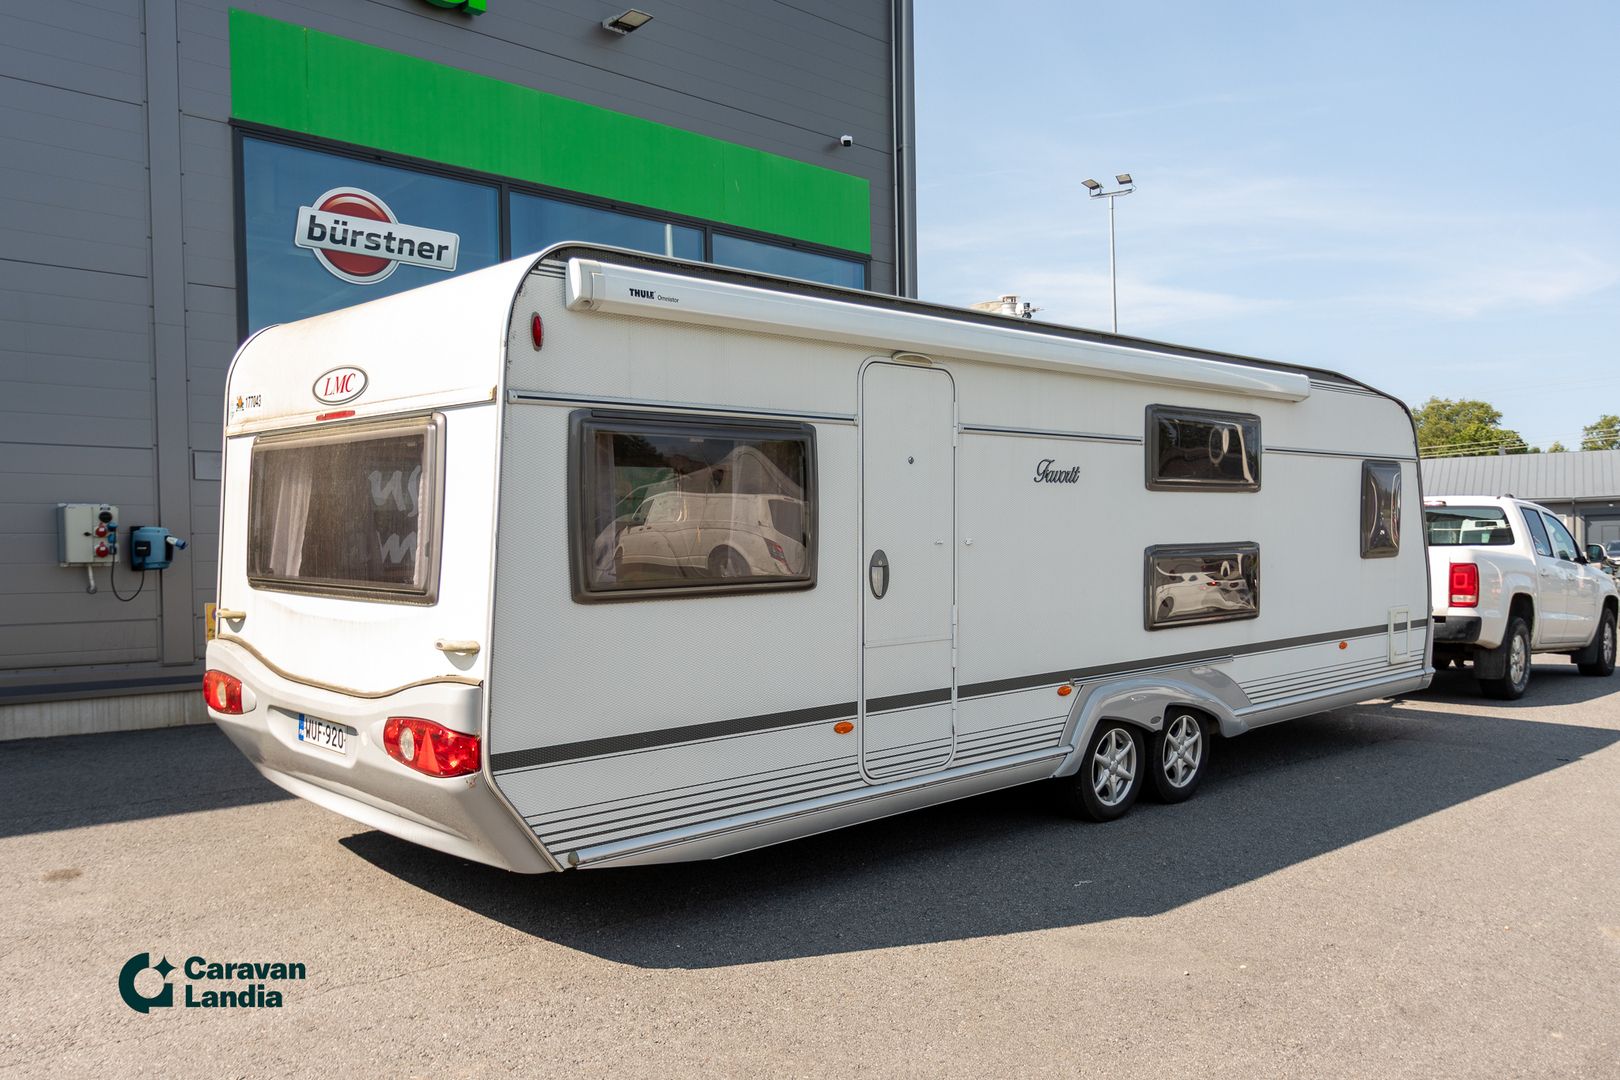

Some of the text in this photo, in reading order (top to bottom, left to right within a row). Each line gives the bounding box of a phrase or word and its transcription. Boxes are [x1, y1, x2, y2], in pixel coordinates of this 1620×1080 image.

[306, 214, 449, 262] bürstner
[629, 287, 655, 300] THULE
[323, 372, 356, 397] LMC
[305, 717, 344, 749] WUF-920
